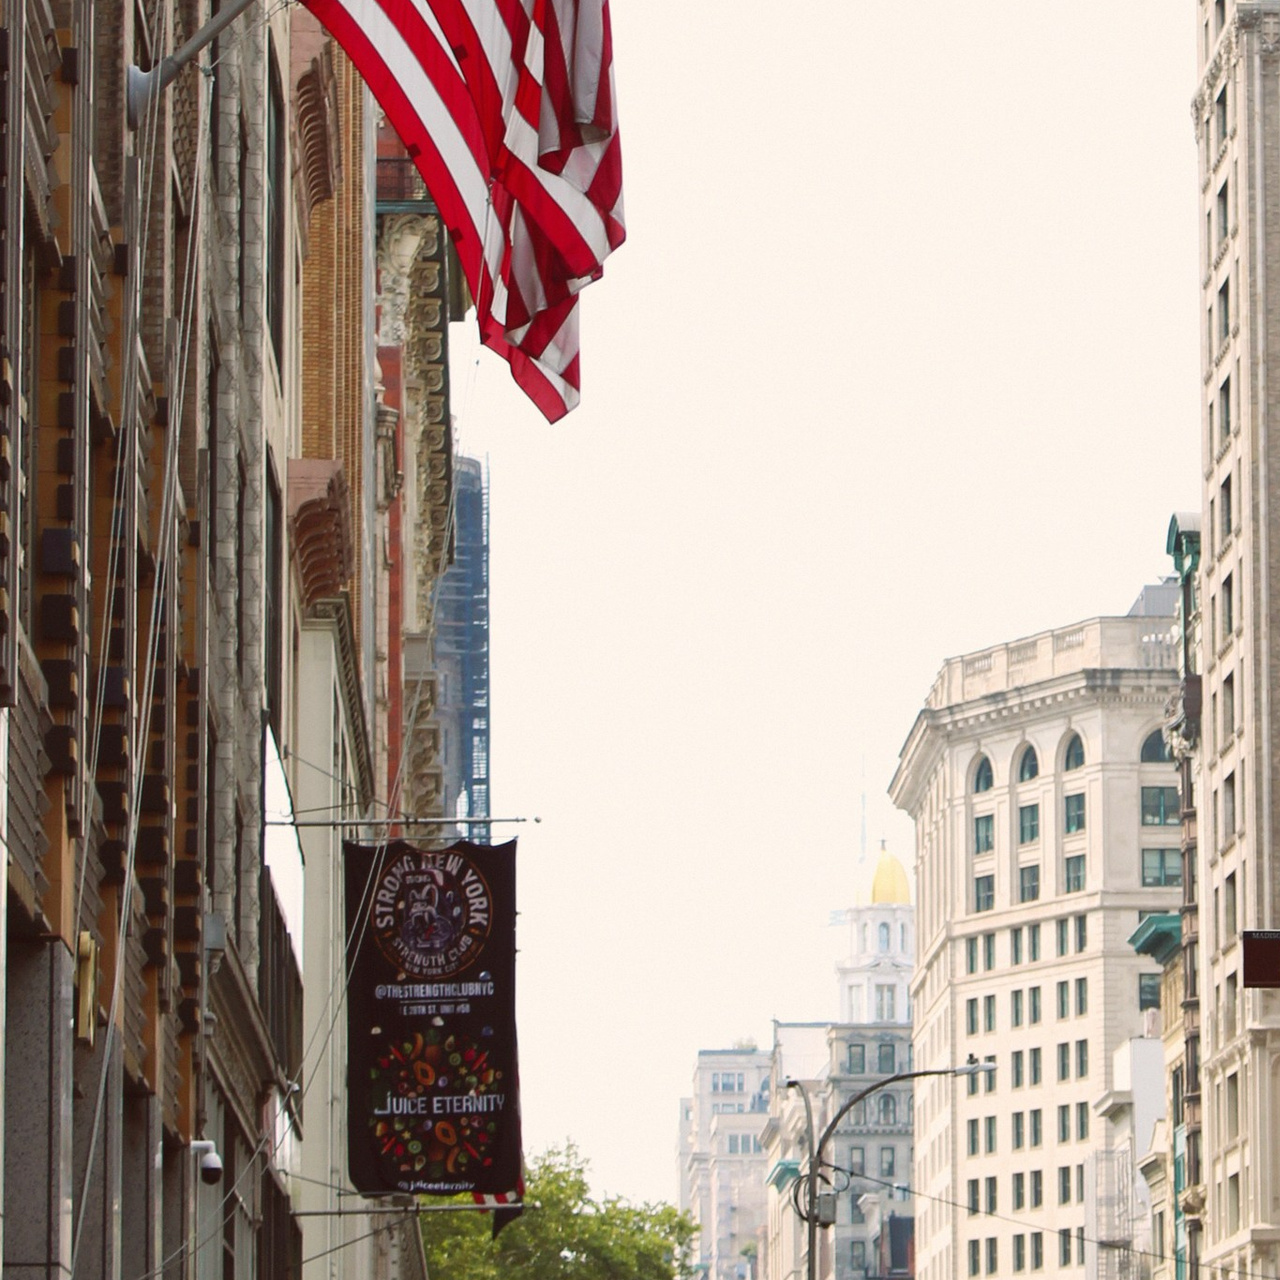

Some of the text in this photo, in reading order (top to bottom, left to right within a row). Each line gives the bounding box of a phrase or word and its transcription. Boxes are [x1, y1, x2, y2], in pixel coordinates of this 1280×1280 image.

[376, 853, 489, 928] STRONG NEW YORK
[392, 935, 473, 967] STRENGTH CLUB
[375, 982, 494, 999] @THESTRENGTHCLUBNYC
[374, 1092, 505, 1115] JUICE ETERNITY
